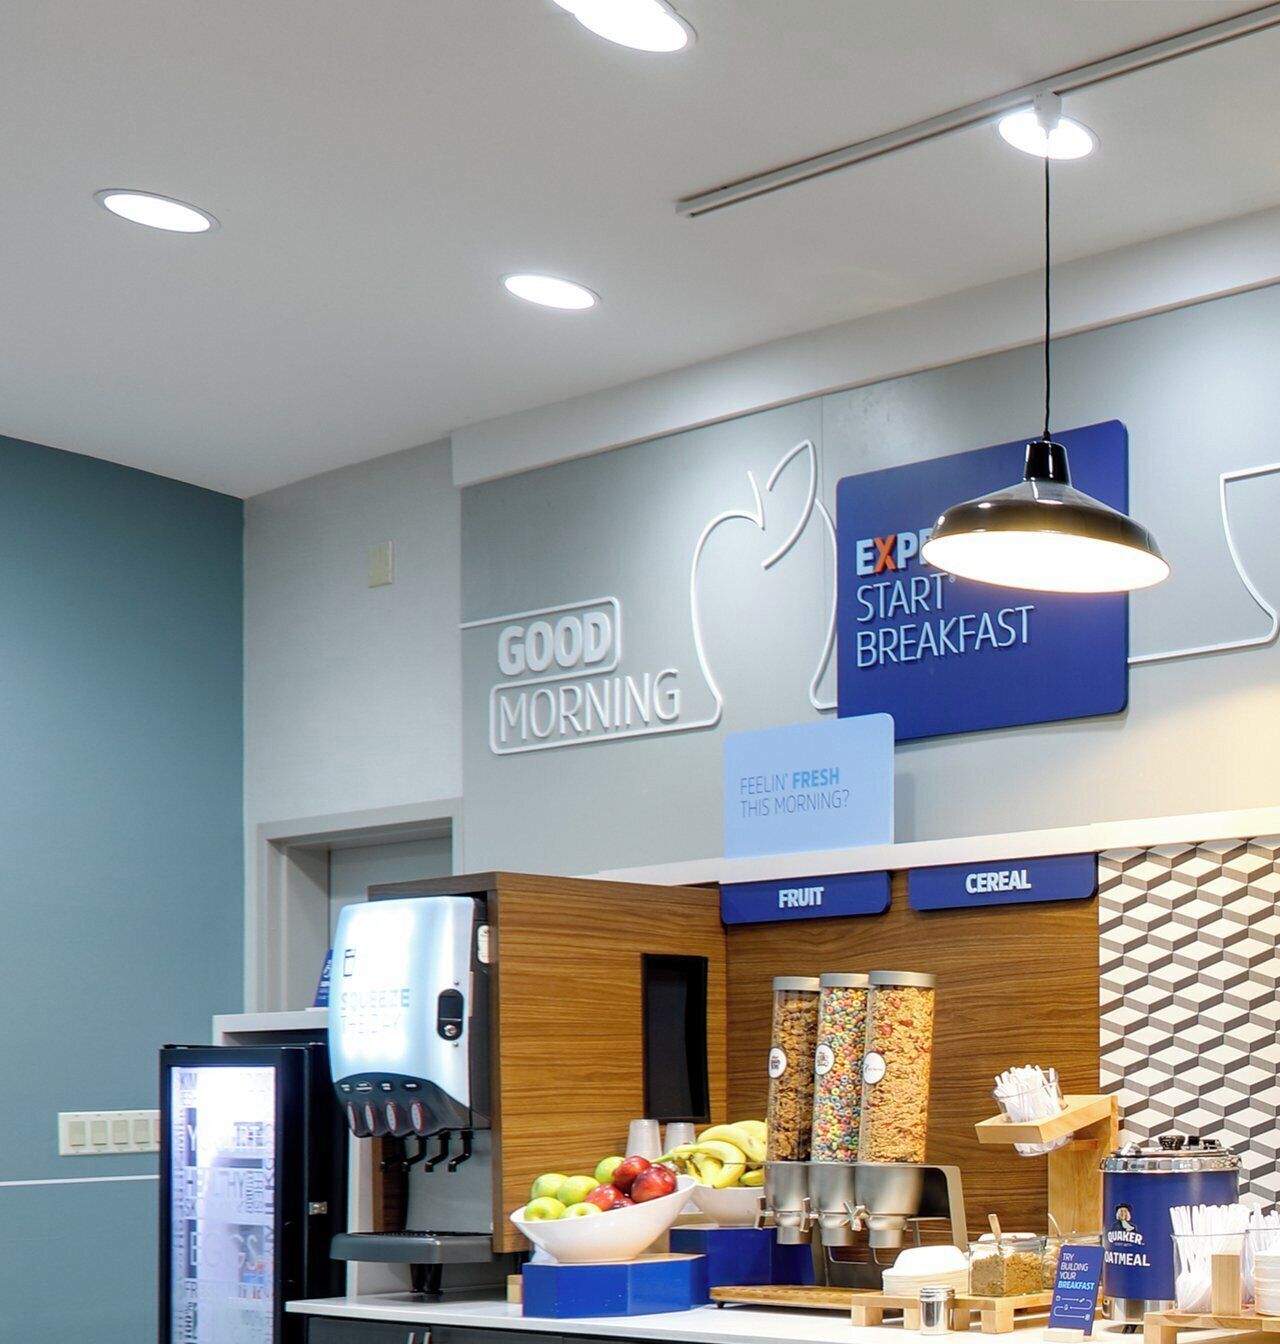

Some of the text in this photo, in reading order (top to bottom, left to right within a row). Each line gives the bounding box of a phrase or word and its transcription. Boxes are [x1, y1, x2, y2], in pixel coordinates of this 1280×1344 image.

[498, 611, 612, 676] GOOD
[857, 605, 1035, 667] BREAKFAST
[501, 668, 680, 743] MORNING
[792, 767, 840, 789] FRESH
[740, 789, 850, 818] THIS MORNING?
[965, 869, 1032, 894] CEREAL
[778, 886, 824, 908] FRUIT
[1107, 1230, 1143, 1246] QUAKER
[1060, 1262, 1088, 1271] BUILDING
[1062, 1253, 1074, 1261] TRY
[1104, 1250, 1151, 1266] OATMEAL
[1058, 1281, 1095, 1291] BREAKFAST
[1060, 1272, 1077, 1280] YOUR
